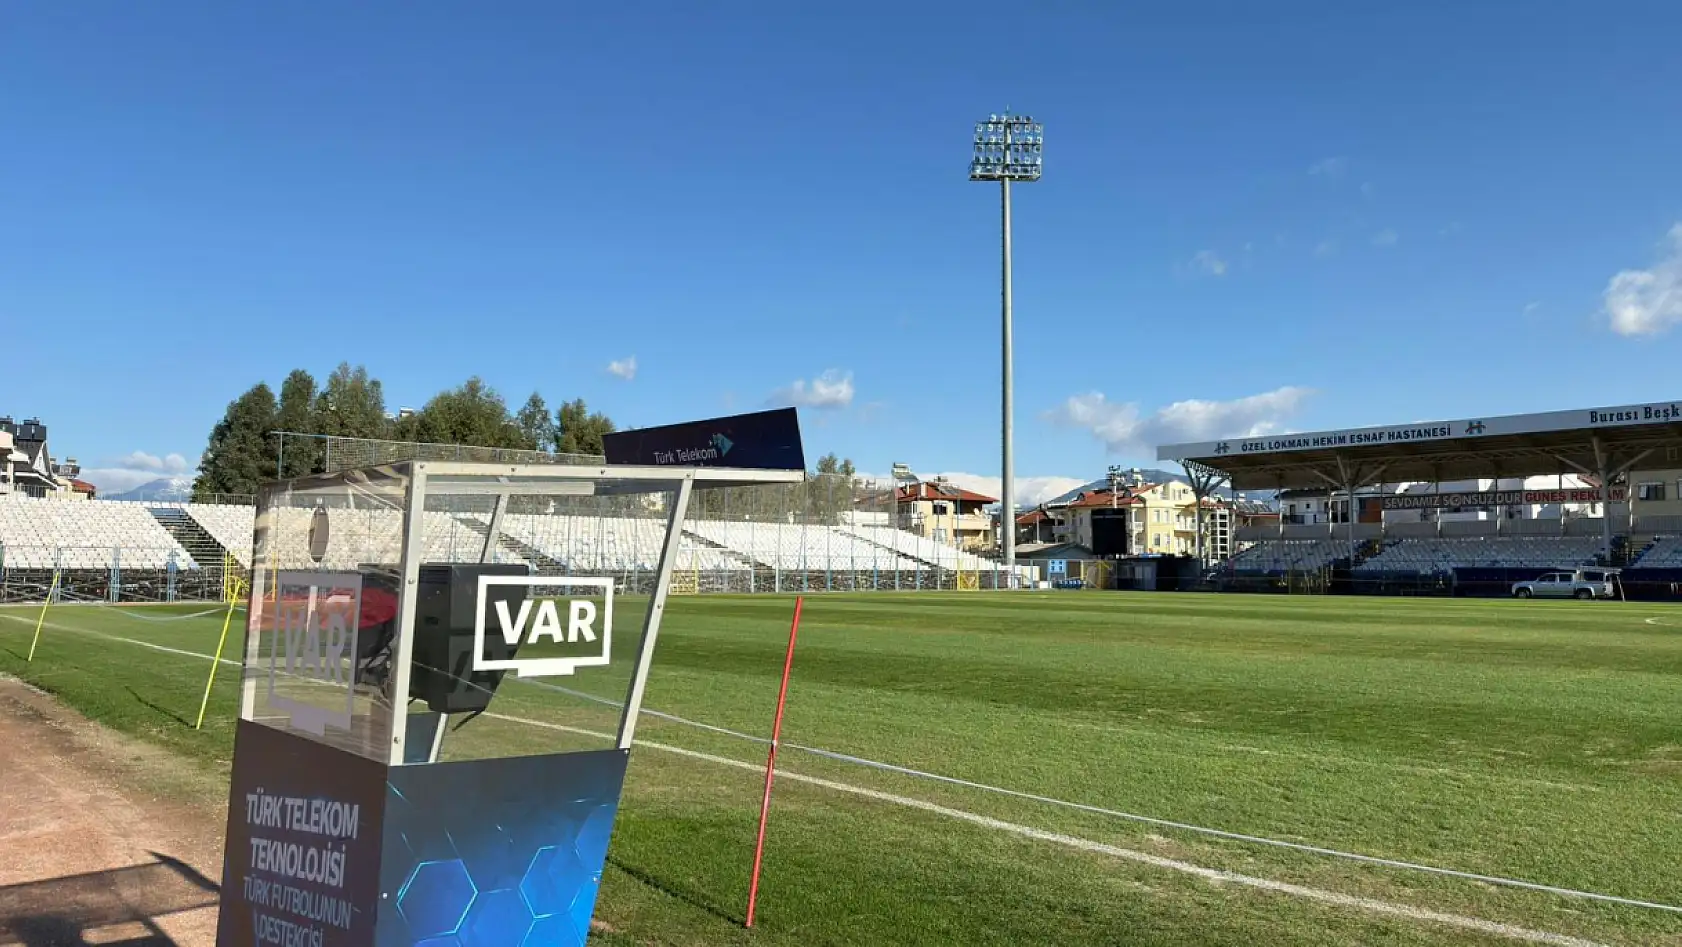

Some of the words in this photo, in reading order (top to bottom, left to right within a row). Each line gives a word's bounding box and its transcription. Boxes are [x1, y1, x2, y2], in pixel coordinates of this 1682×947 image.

[1241, 440, 1265, 452] ÖZEL
[1268, 438, 1310, 450] LOKMAN
[1313, 434, 1346, 446] HEKİM
[1350, 431, 1384, 443] ESNAF
[1388, 424, 1451, 440] HASTANESİ
[1590, 411, 1638, 423] Burası
[676, 447, 718, 462] Telekom
[1384, 496, 1440, 509] SEVDAMIZ
[284, 606, 347, 684] VAR
[494, 599, 597, 645] VAR
[246, 787, 283, 827] TÜRK
[285, 797, 359, 840] TELEKOM
[250, 837, 346, 888] TEKNOLOJİSİ
[243, 874, 273, 906] TÜRK
[271, 883, 351, 930] FUTBOLUNUN
